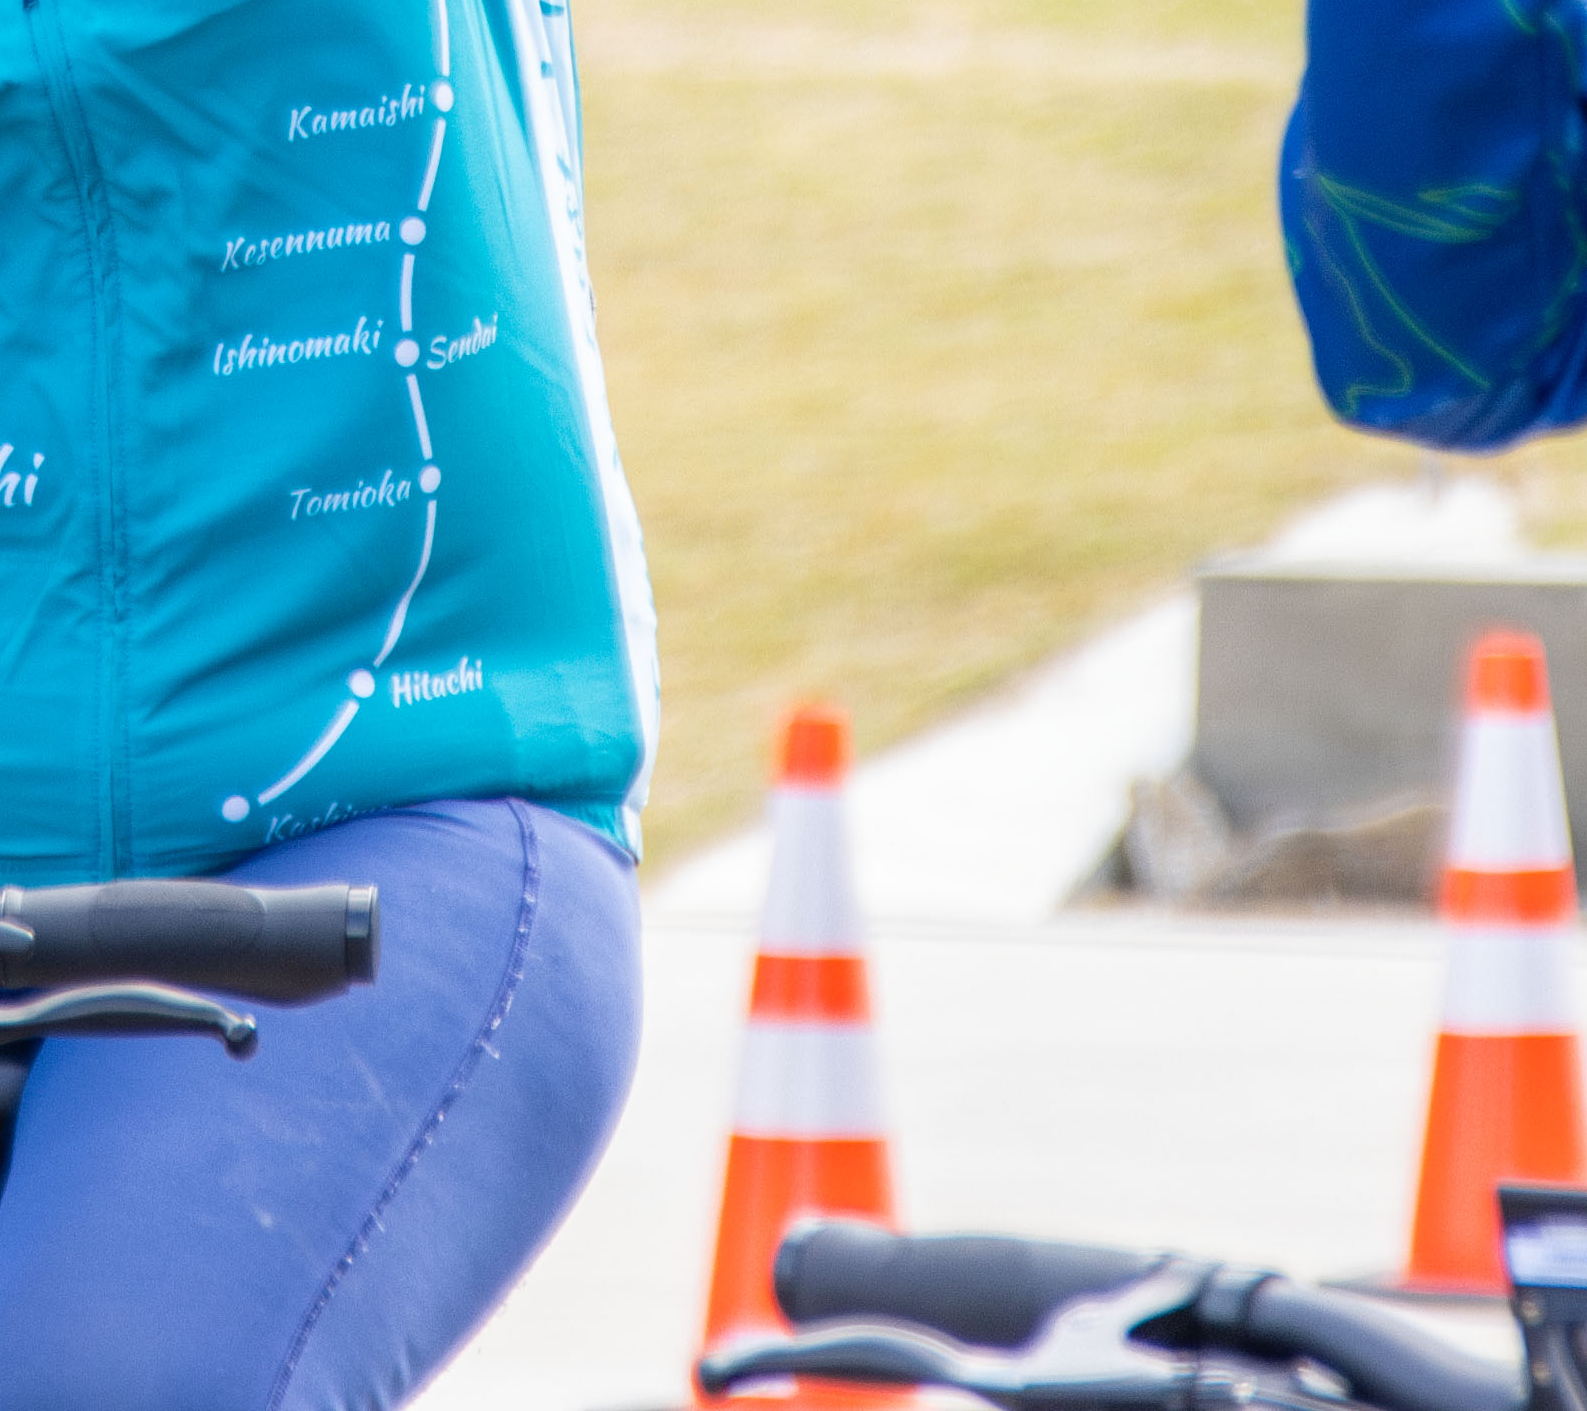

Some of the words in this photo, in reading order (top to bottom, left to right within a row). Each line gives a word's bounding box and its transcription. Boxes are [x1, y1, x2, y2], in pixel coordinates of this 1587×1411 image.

[287, 82, 426, 143] Kamaishi
[220, 220, 392, 274] Kesennuma
[212, 315, 385, 376] Ishinomaki
[425, 311, 500, 371] Sendai
[289, 468, 412, 522] Tomioka
[389, 654, 485, 710] Hitachi
